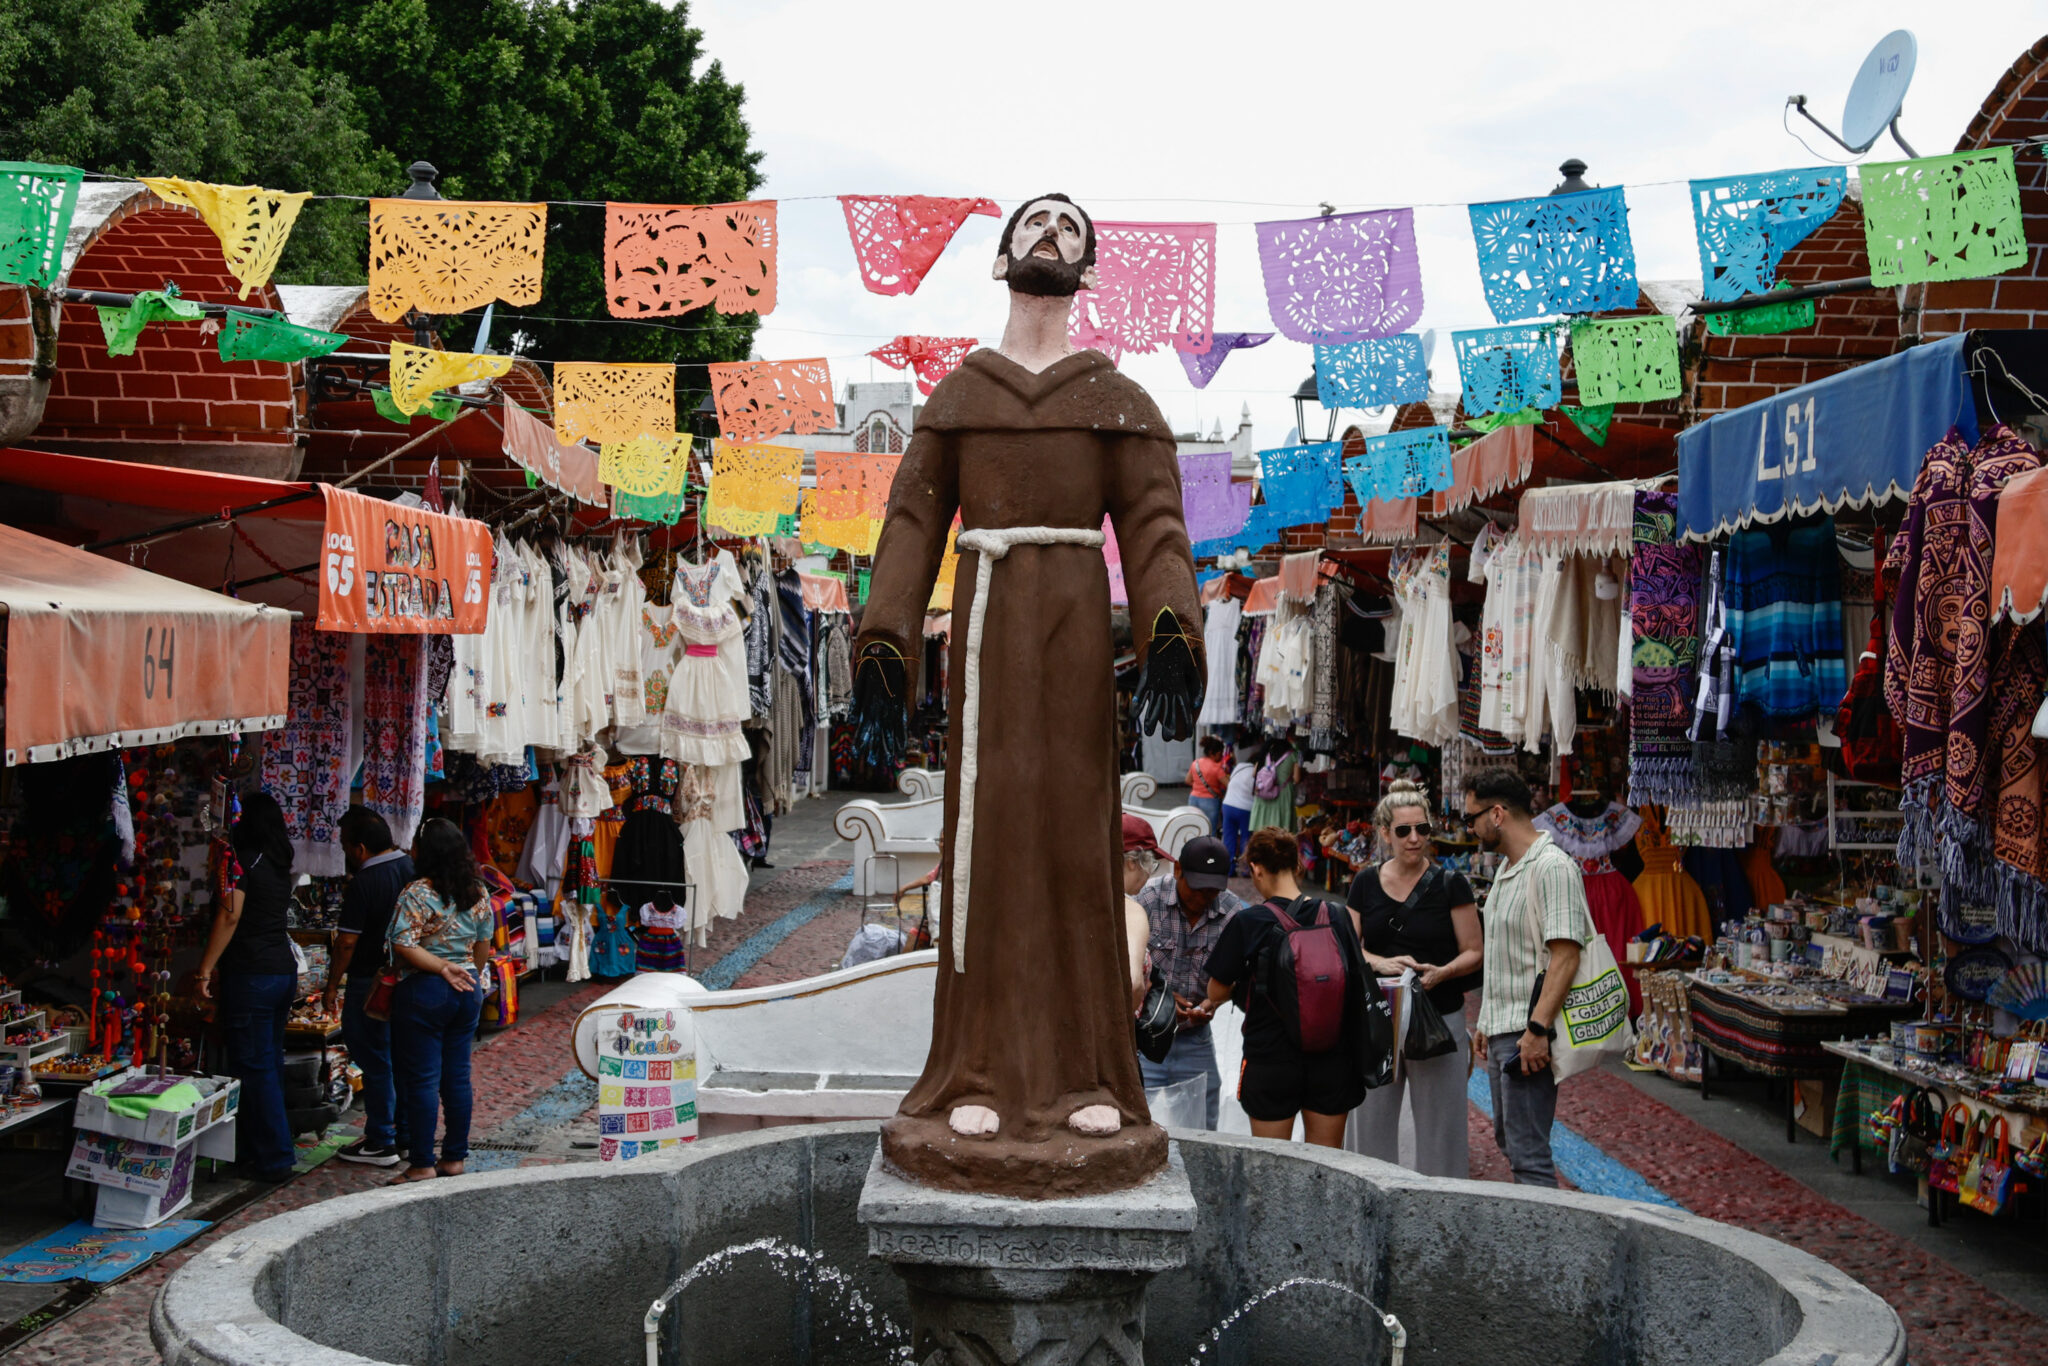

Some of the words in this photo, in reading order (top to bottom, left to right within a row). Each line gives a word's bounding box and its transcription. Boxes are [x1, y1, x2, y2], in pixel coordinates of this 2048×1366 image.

[327, 533, 355, 551] LOCAL
[384, 519, 436, 570] CASA
[327, 553, 355, 597] 65
[366, 570, 454, 620] ESTRADA
[144, 626, 175, 699] 64
[613, 1033, 682, 1056] Picado
[617, 1011, 675, 1039] Papel
